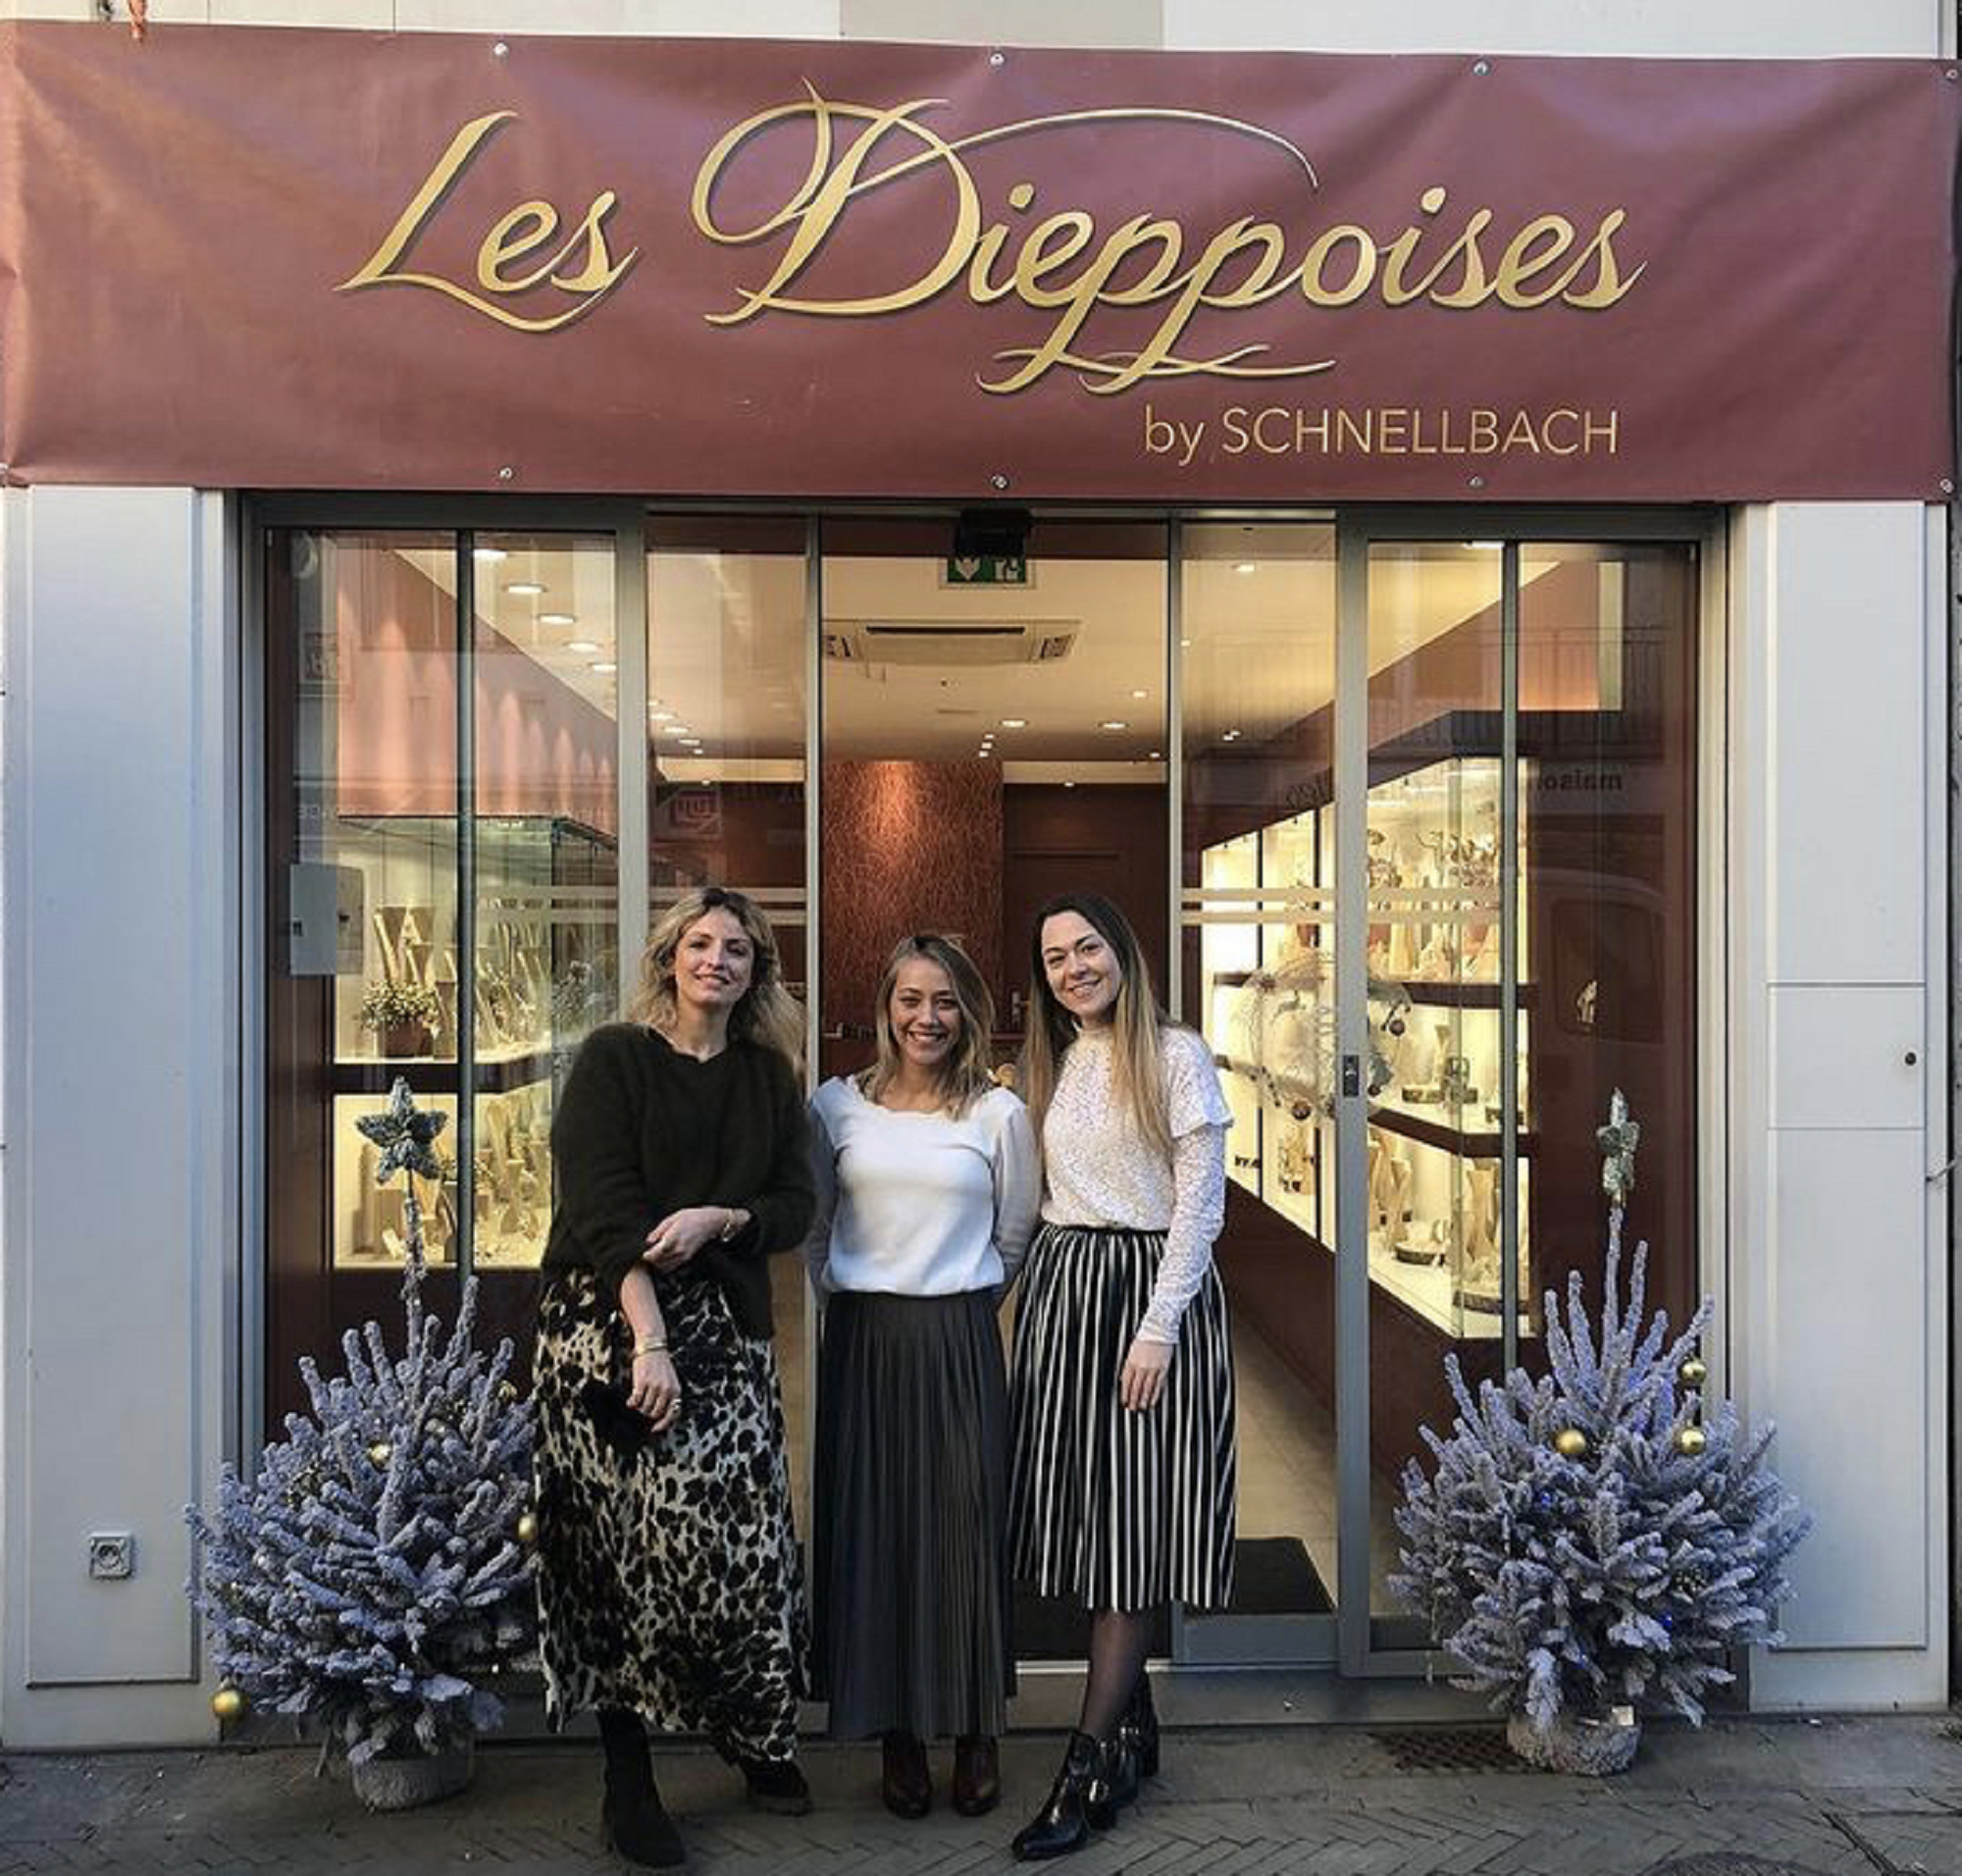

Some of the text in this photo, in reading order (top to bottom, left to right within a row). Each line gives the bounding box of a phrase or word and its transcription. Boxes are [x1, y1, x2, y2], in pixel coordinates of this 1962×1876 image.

[334, 75, 1648, 395] Les Dieppoises
[1144, 404, 1620, 467] by SCHNELLBACH
